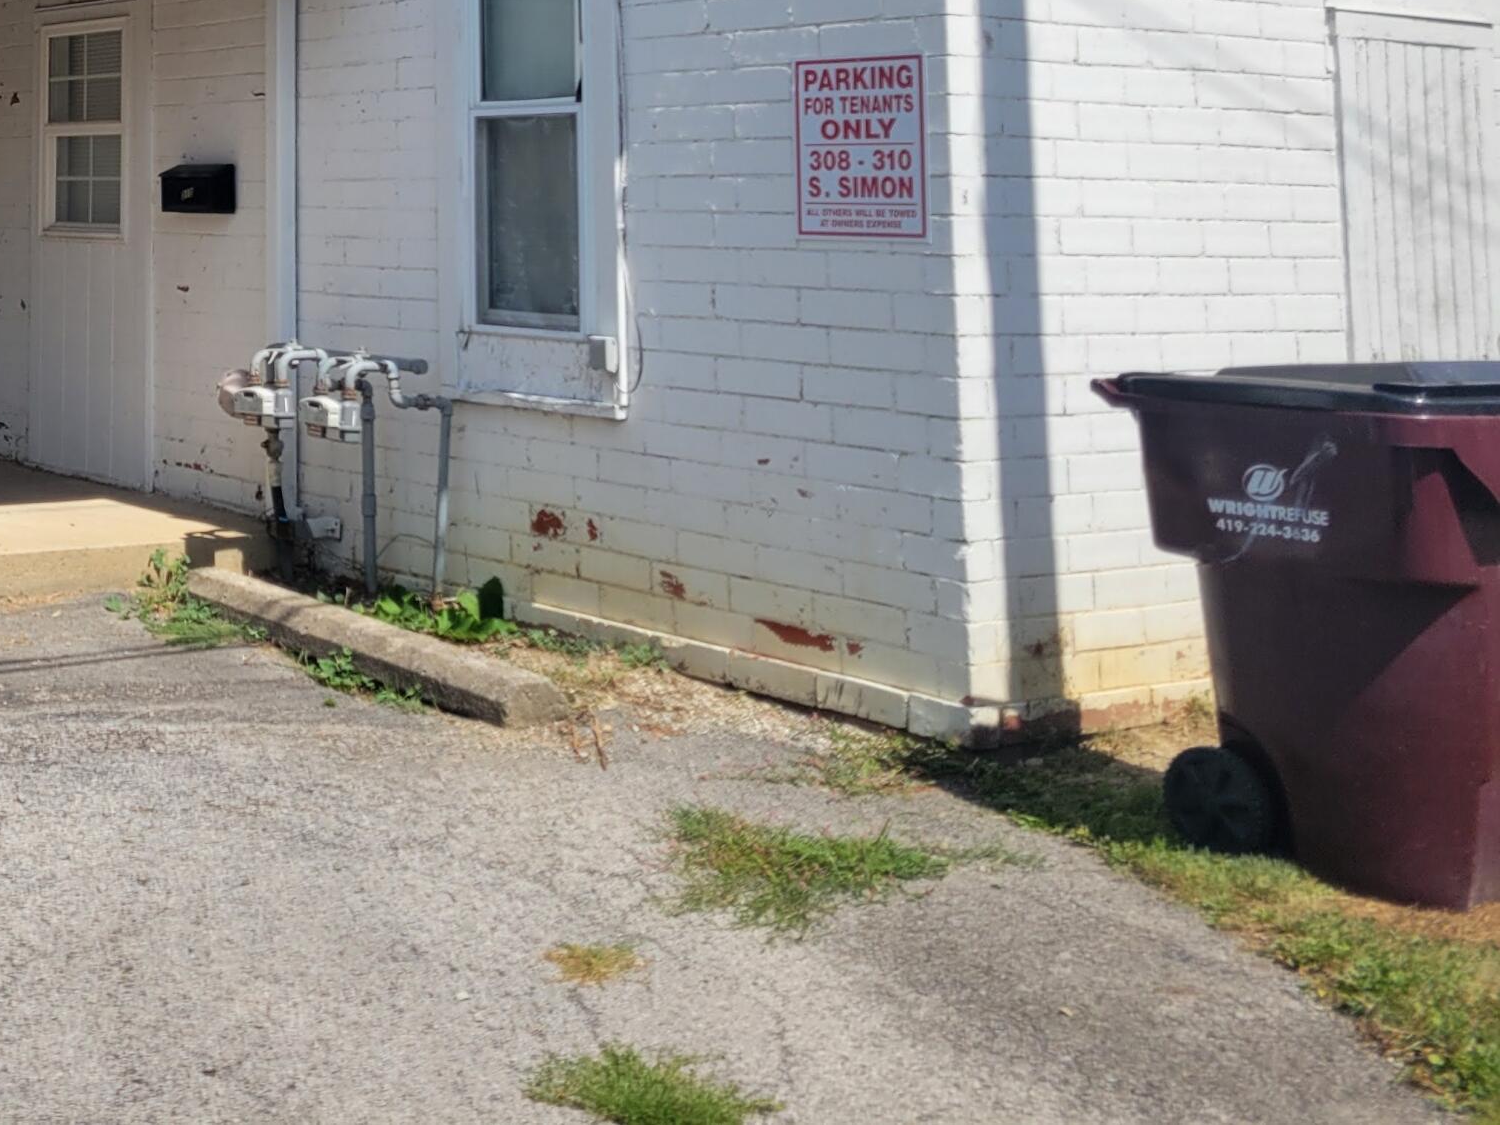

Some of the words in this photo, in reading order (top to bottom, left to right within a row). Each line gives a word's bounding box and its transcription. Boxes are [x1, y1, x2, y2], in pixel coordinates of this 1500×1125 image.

[804, 64, 914, 92] PARKING
[804, 97, 834, 115] FOR
[839, 94, 914, 114] TENANTS
[820, 118, 897, 140] ONLY
[809, 150, 851, 171] 308
[872, 149, 912, 171] 310
[808, 177, 831, 198] S.
[838, 177, 914, 199] SIMON
